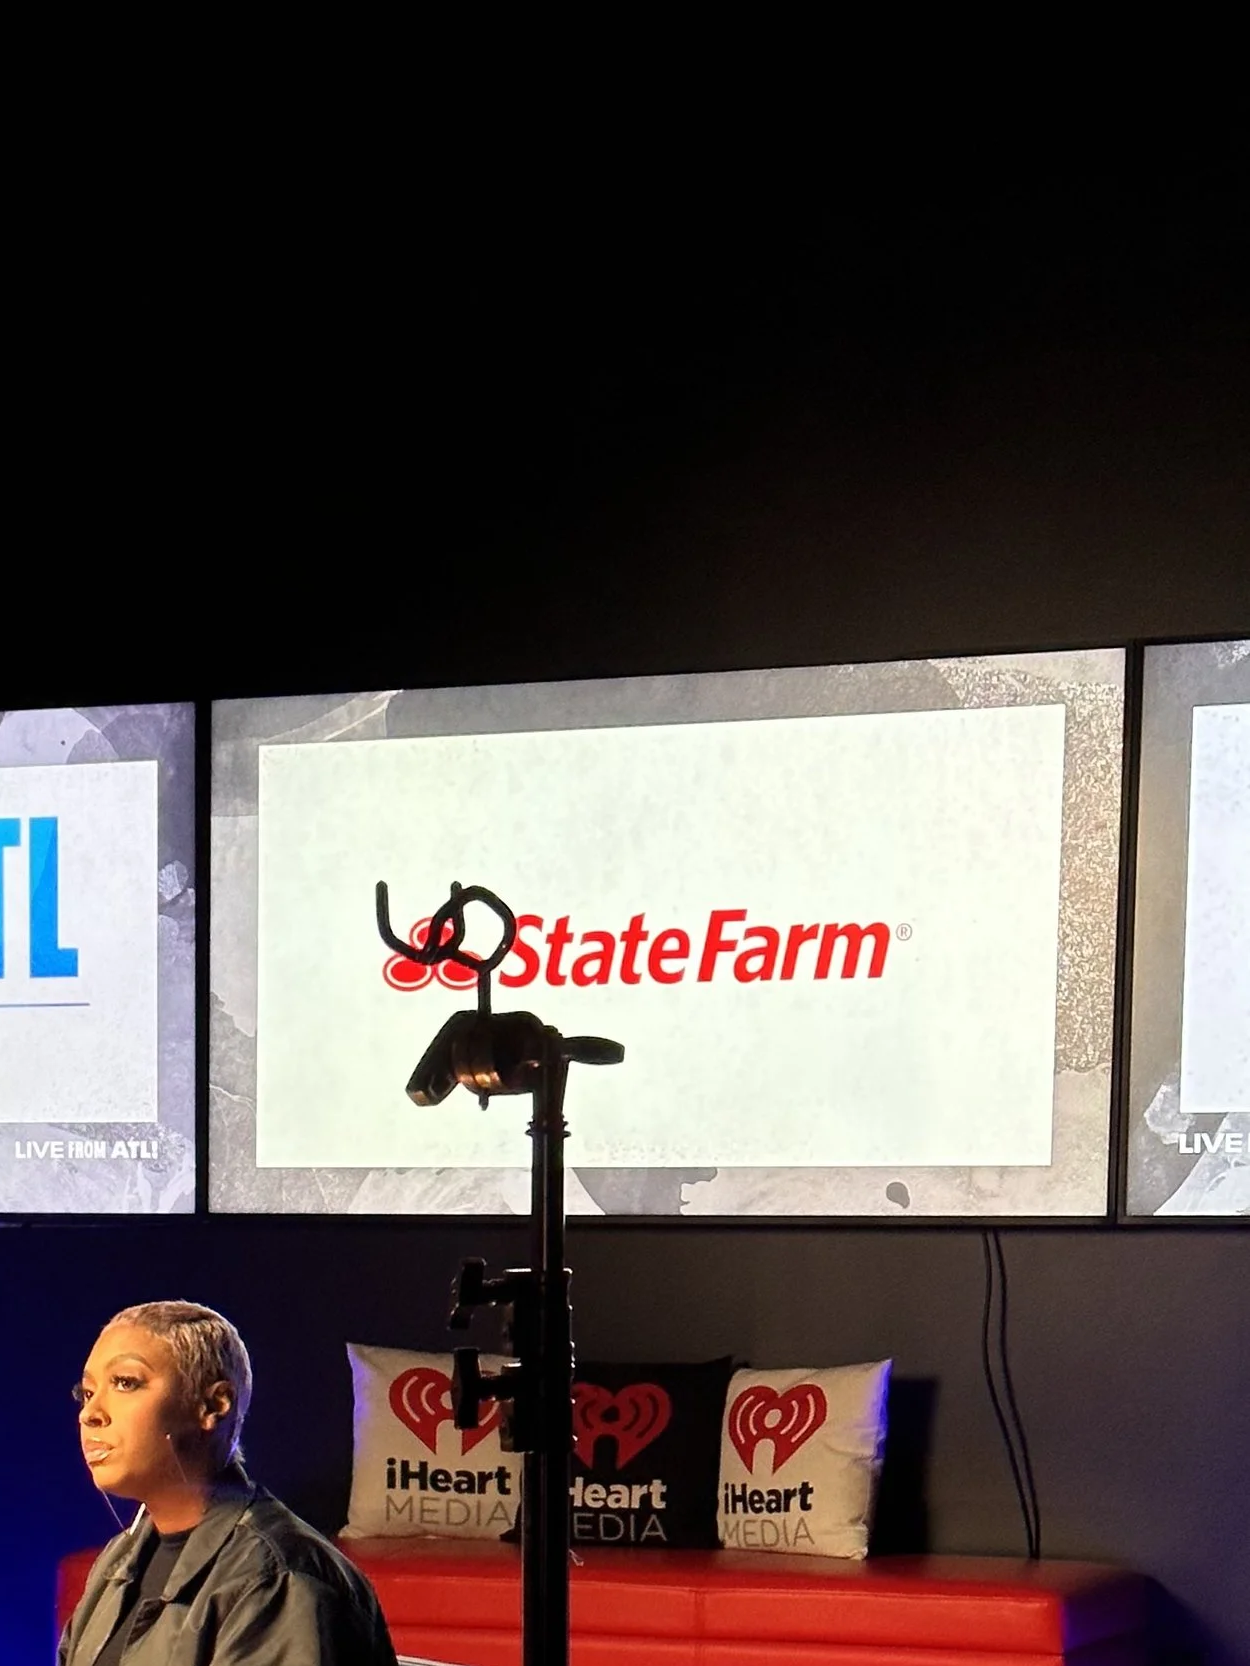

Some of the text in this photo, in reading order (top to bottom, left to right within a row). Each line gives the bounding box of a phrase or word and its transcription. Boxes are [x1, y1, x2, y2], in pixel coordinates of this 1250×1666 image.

[14, 1140, 159, 1159] LIVE FROM ATL!
[1178, 1131, 1244, 1155] LIVE
[386, 1457, 512, 1496] iHeart
[385, 1494, 513, 1528] MEDIA
[723, 1481, 815, 1515] iHeart
[572, 1512, 669, 1543] EDIA
[721, 1516, 816, 1549] MEDIA
